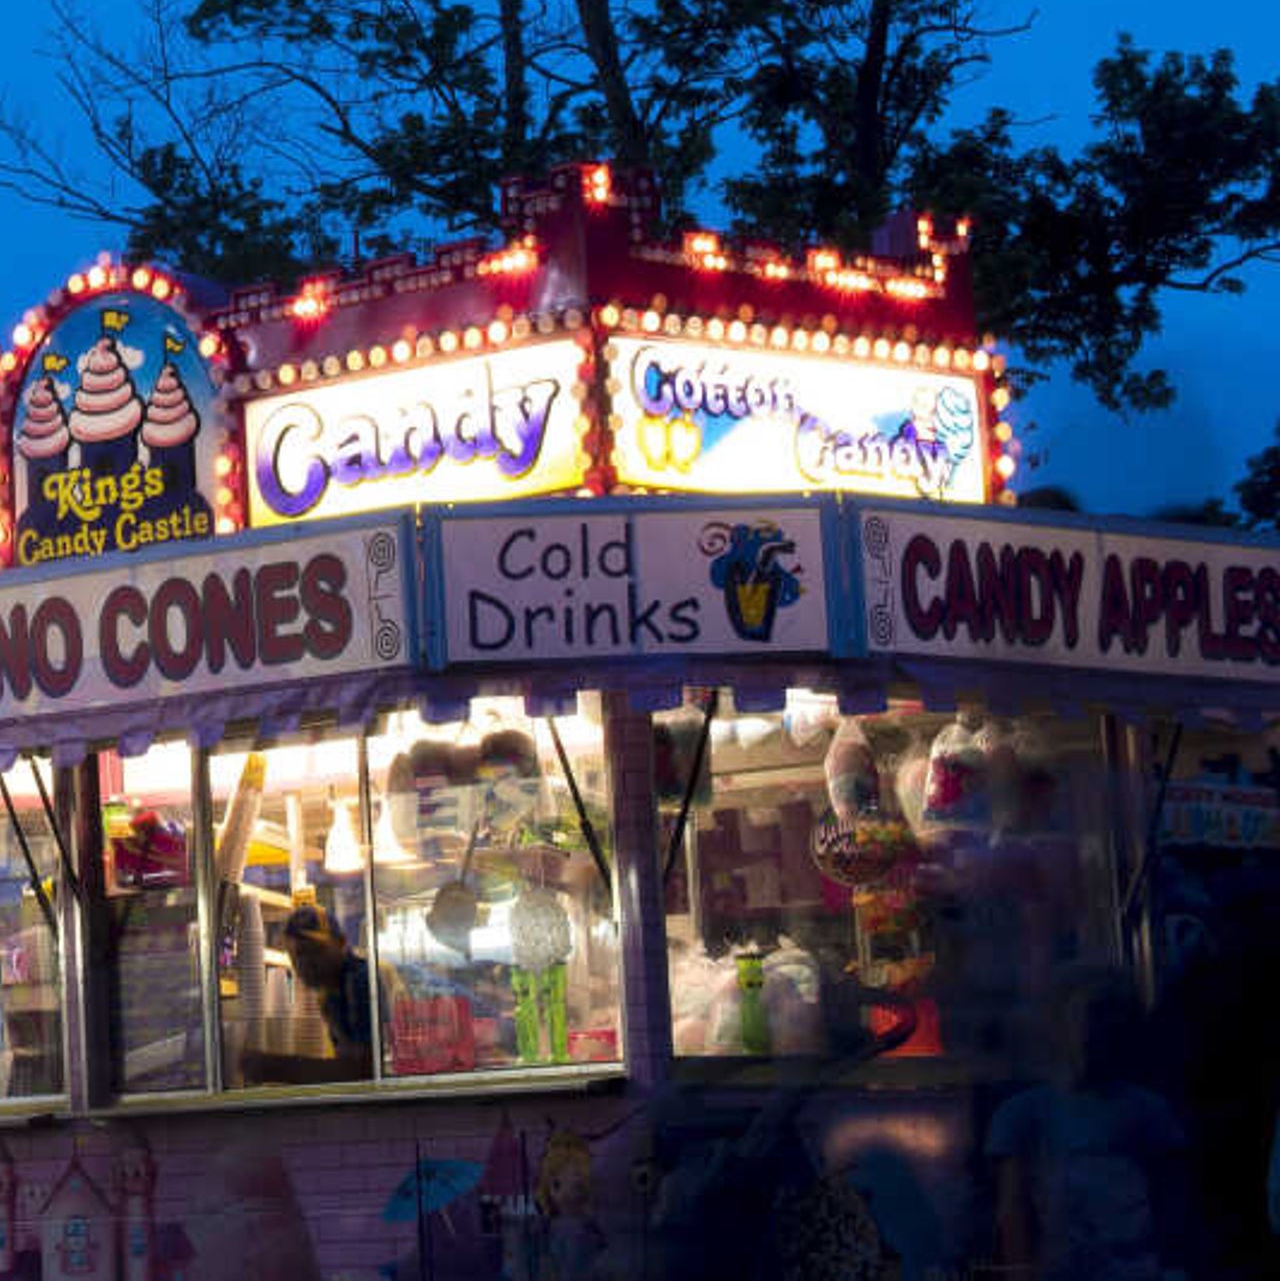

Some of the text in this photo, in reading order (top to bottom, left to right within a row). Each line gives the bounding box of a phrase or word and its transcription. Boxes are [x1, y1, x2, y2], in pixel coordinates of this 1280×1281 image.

[631, 346, 796, 418] Cotton
[256, 359, 560, 517] Candy
[18, 508, 210, 565] Candy Castle
[497, 522, 635, 582] Cold
[99, 554, 353, 681] CONES
[467, 588, 702, 651] Drinks
[900, 533, 1280, 667] CANDY APPLES
